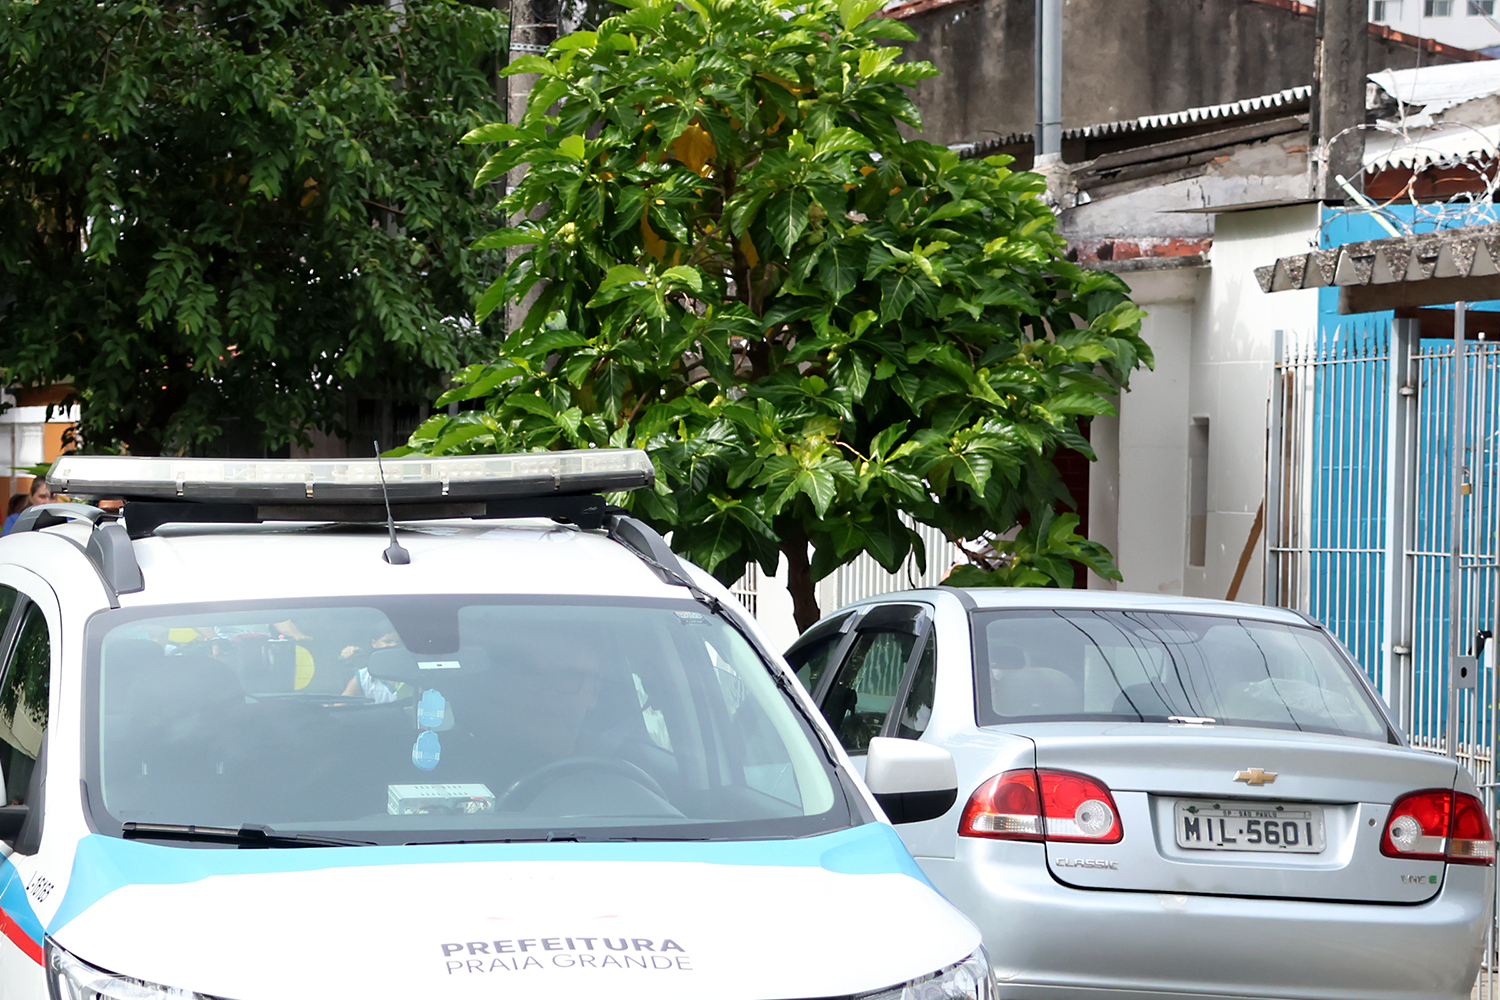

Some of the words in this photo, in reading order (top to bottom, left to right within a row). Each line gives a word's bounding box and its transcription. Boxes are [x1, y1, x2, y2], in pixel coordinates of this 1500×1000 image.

[1055, 857, 1119, 871] CLASSIC
[441, 937, 686, 957] PREFEITURA
[446, 955, 544, 975] PRAIA
[551, 954, 693, 971] GRANDE
